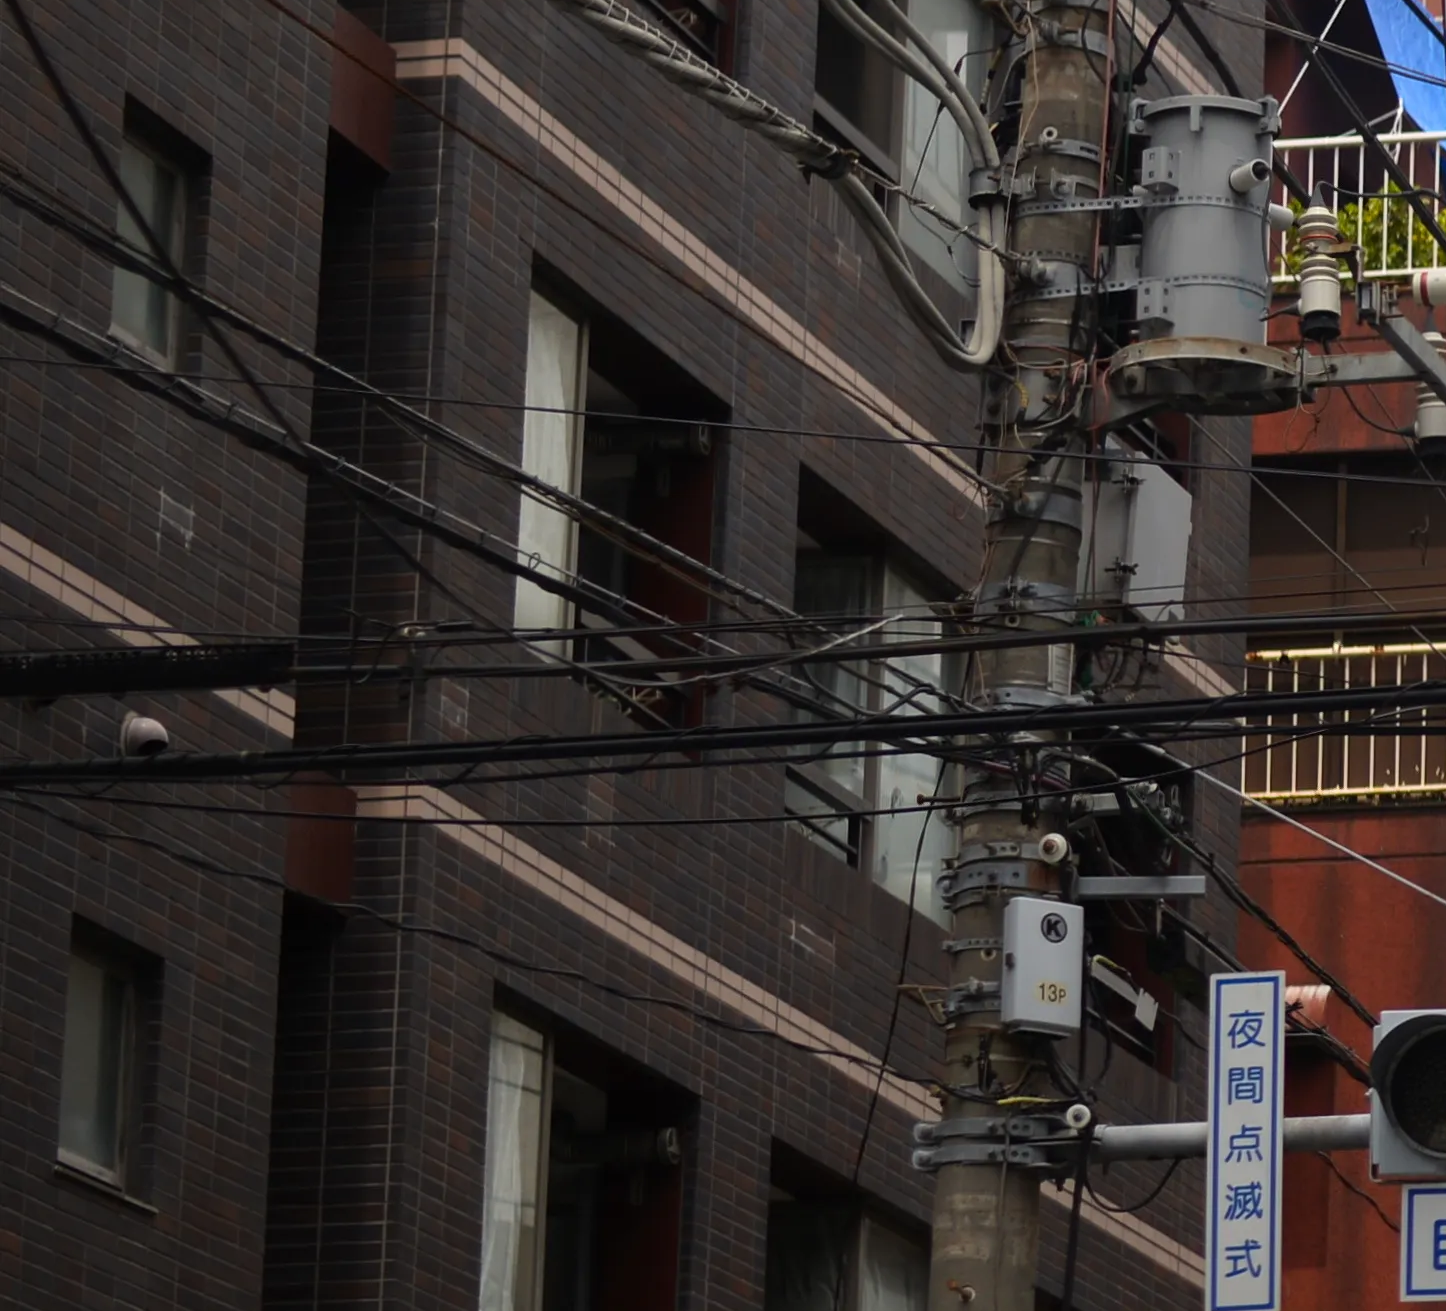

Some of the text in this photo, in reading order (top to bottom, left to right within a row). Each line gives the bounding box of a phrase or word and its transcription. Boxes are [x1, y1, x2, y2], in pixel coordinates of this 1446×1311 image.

[1224, 1008, 1267, 1280] 夜間点滅式
